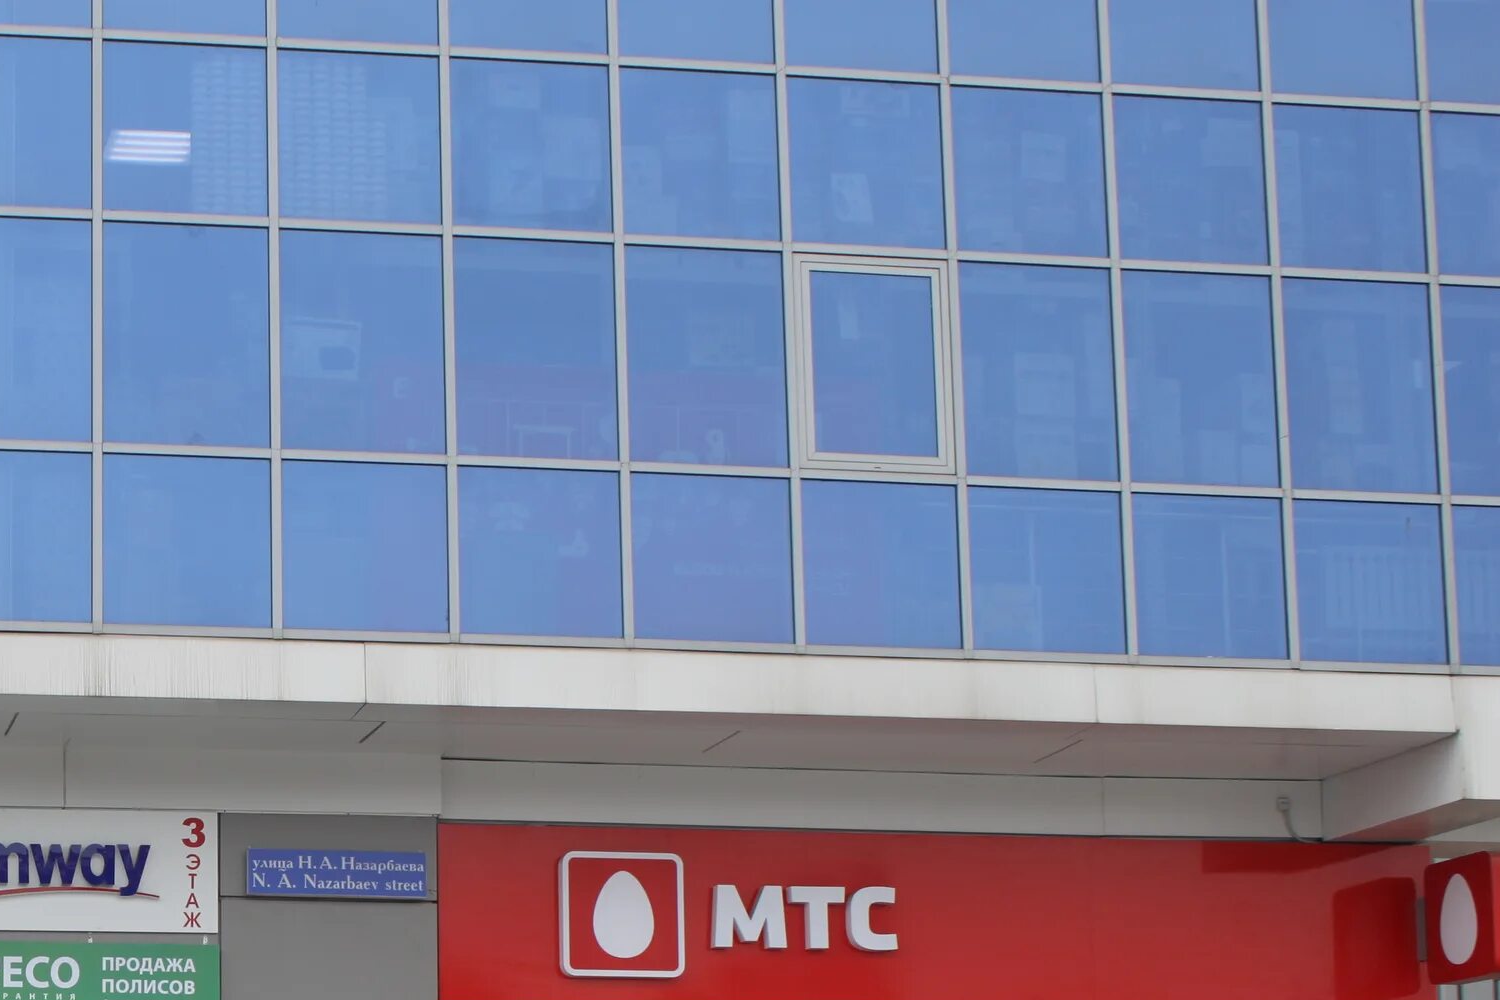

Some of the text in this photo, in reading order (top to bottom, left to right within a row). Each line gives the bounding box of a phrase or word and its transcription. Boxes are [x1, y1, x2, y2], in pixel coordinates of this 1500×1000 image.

[182, 817, 206, 929] 3 ЭТАЖ
[252, 859, 294, 871] улица
[341, 856, 425, 874] Назарбаева
[303, 873, 379, 890] Nazarbaev
[385, 879, 424, 891] street
[710, 884, 899, 952] МТС
[102, 956, 196, 975] ПРОДАЖА
[102, 978, 195, 995] ПОЛИСОВ
